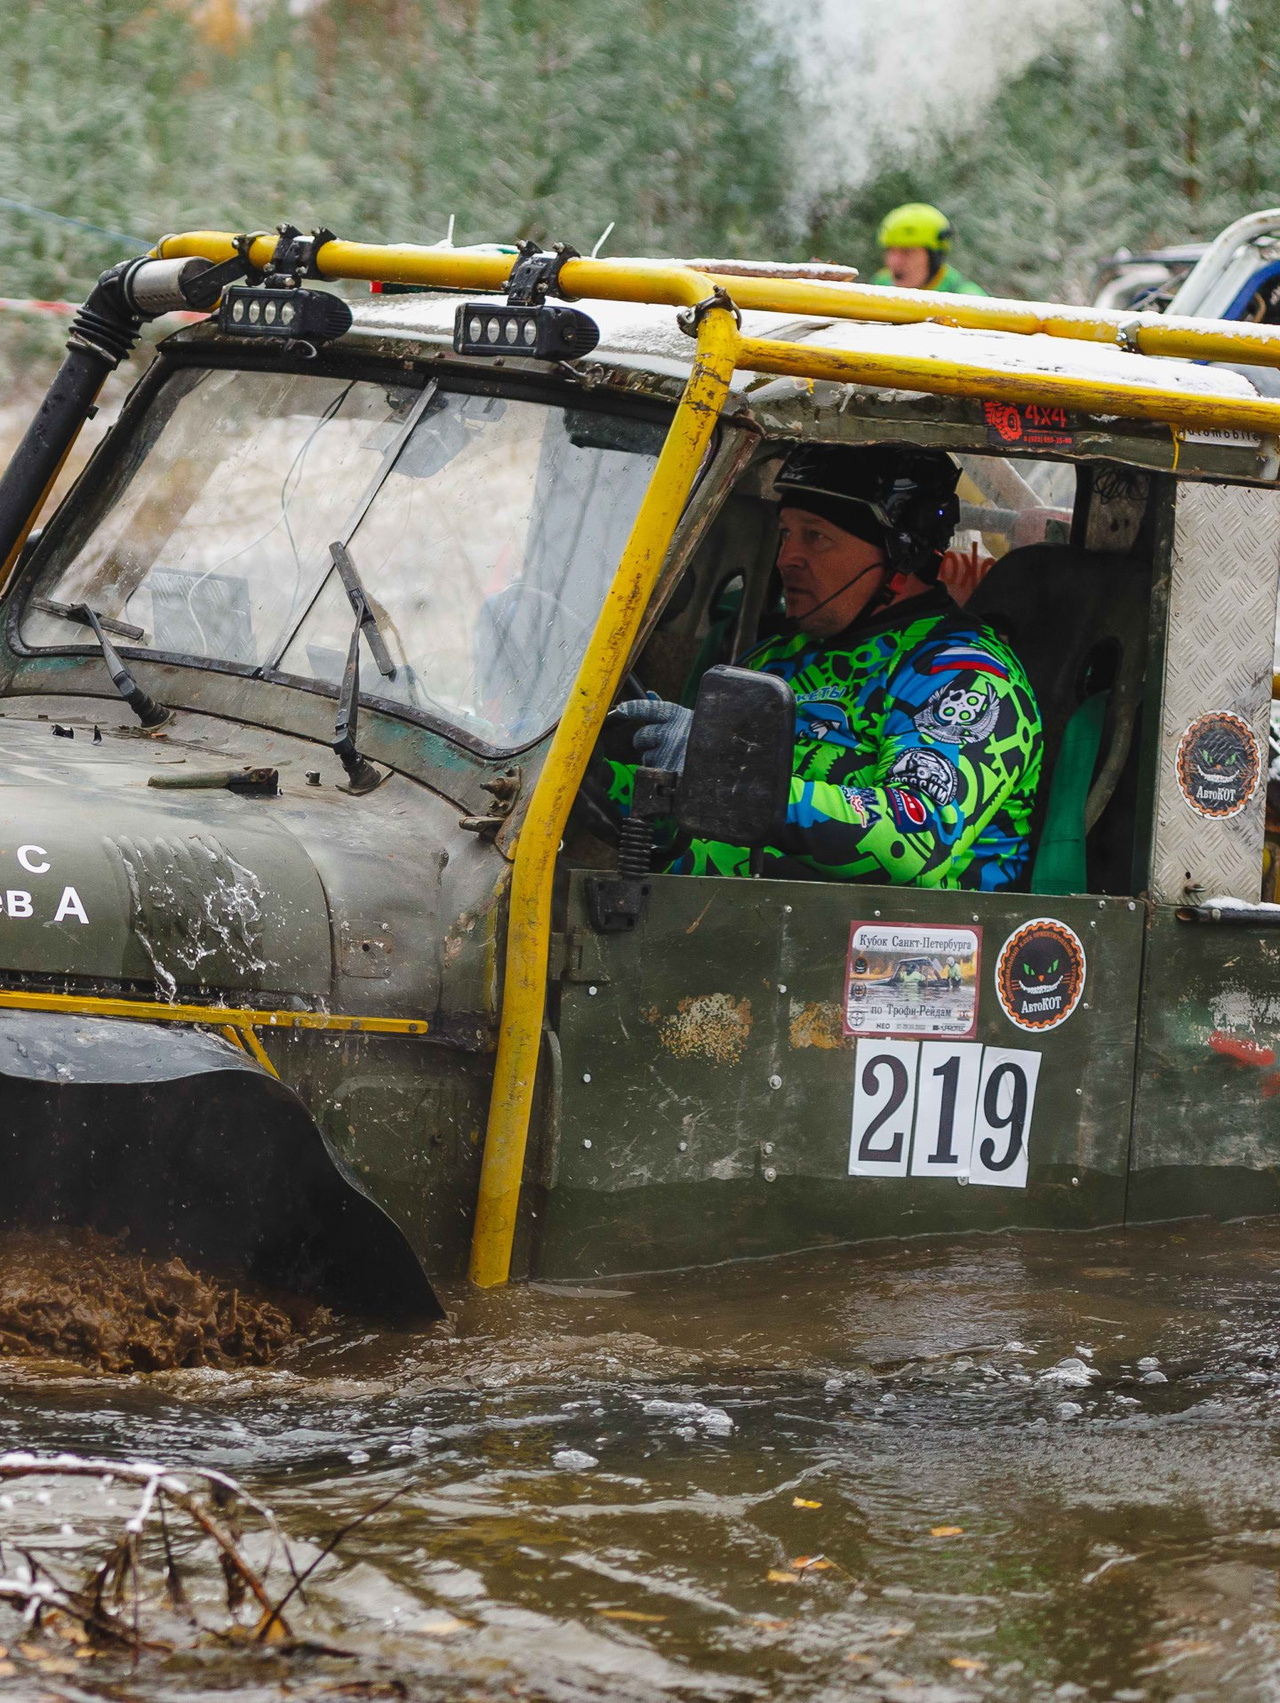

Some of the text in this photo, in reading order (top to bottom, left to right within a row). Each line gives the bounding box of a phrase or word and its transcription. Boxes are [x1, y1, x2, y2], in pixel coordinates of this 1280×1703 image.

[17, 844, 51, 874] С
[53, 886, 90, 924] А
[859, 934, 972, 952] Кубок Санкт-Петербурга
[870, 1003, 952, 1018] по Трофи-Рейдам
[876, 1022, 891, 1030] NEO
[857, 1053, 1029, 1172] 219
